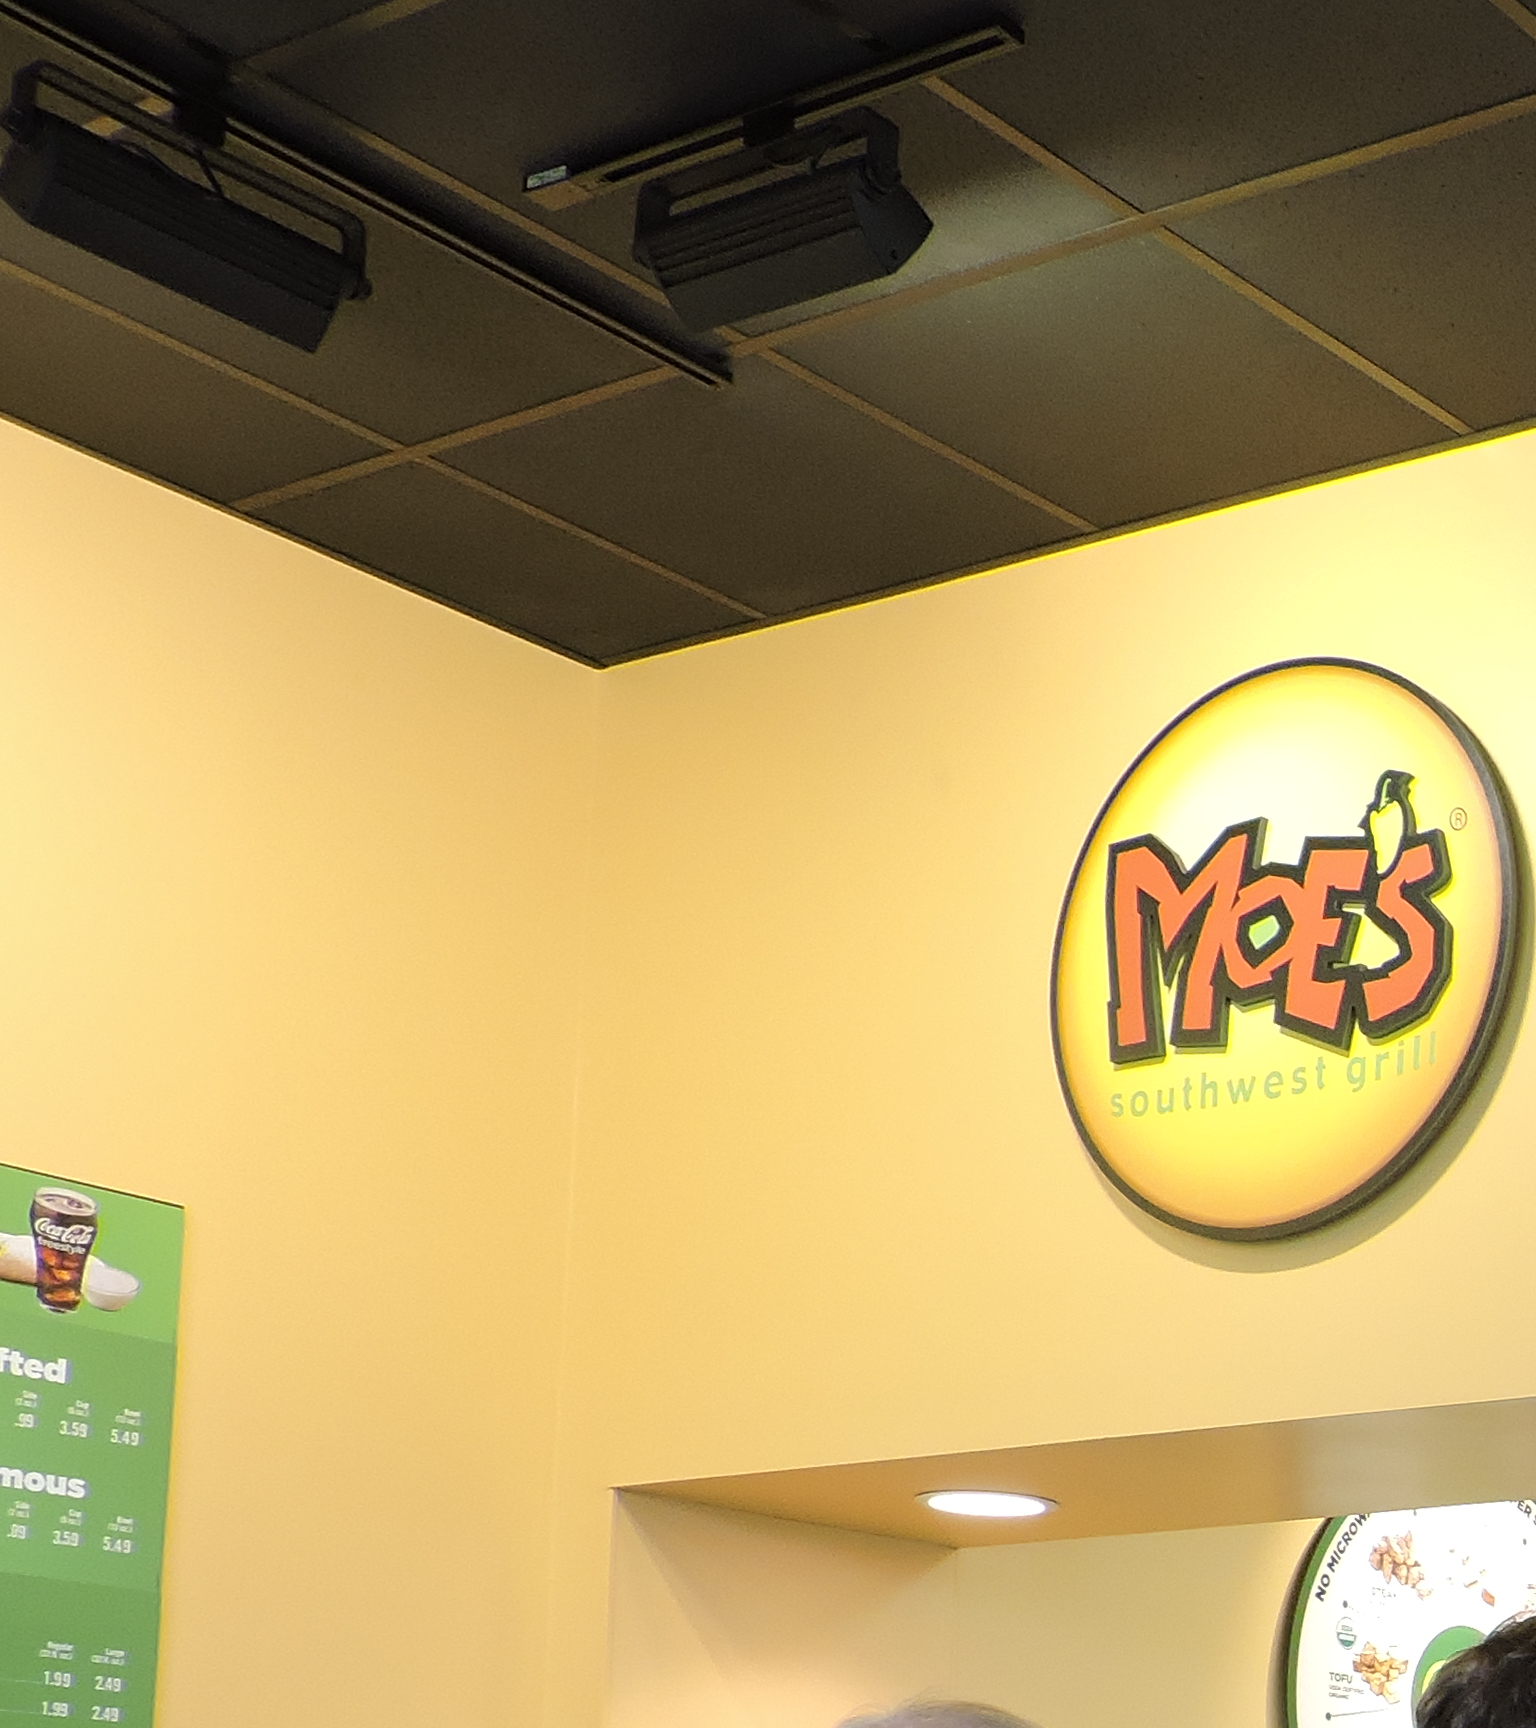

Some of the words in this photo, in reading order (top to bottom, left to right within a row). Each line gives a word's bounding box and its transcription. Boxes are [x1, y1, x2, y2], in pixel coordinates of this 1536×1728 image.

[1111, 1057, 1327, 1117] southwest
[1347, 1031, 1437, 1092] grill
[110, 1428, 140, 1446] 5.49
[0, 1467, 86, 1499] mous
[1511, 1500, 1532, 1519] ER
[102, 1536, 131, 1554] 5.49
[1315, 1573, 1331, 1603] NO
[1326, 1513, 1371, 1573] MICROW
[44, 1671, 71, 1688] 1.99
[94, 1676, 122, 1692] 2.49
[1328, 1671, 1353, 1684] TOFU
[42, 1701, 69, 1718] 1.99
[91, 1706, 119, 1722] 2.49
